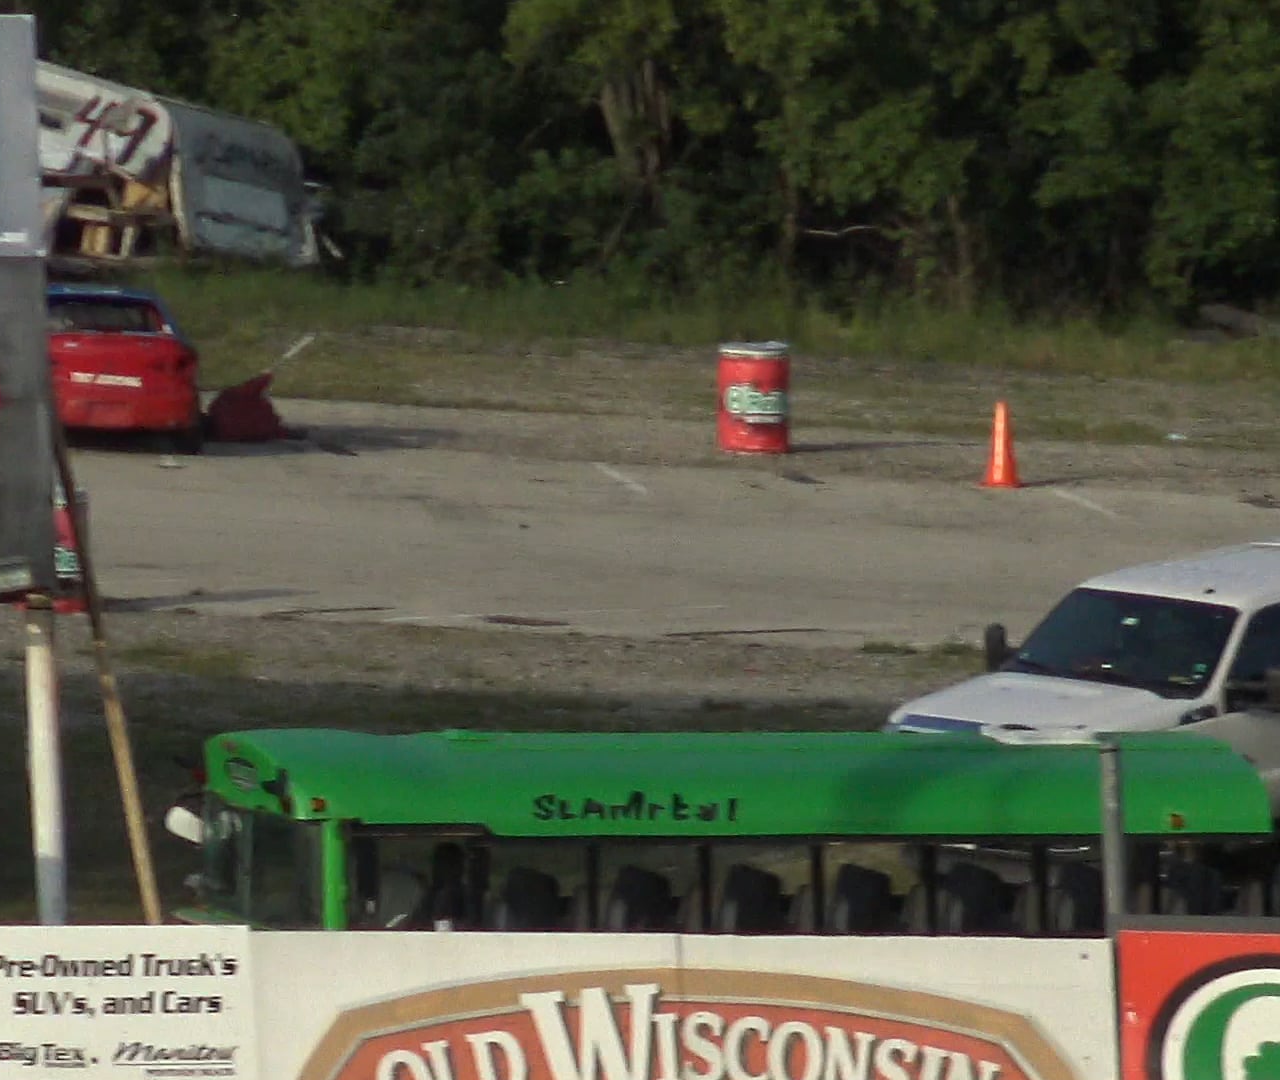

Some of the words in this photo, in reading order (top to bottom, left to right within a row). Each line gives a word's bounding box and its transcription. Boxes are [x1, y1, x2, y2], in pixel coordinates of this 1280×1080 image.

[140, 953, 240, 977] Truck's
[102, 990, 156, 1014] and
[161, 990, 223, 1014] Cars
